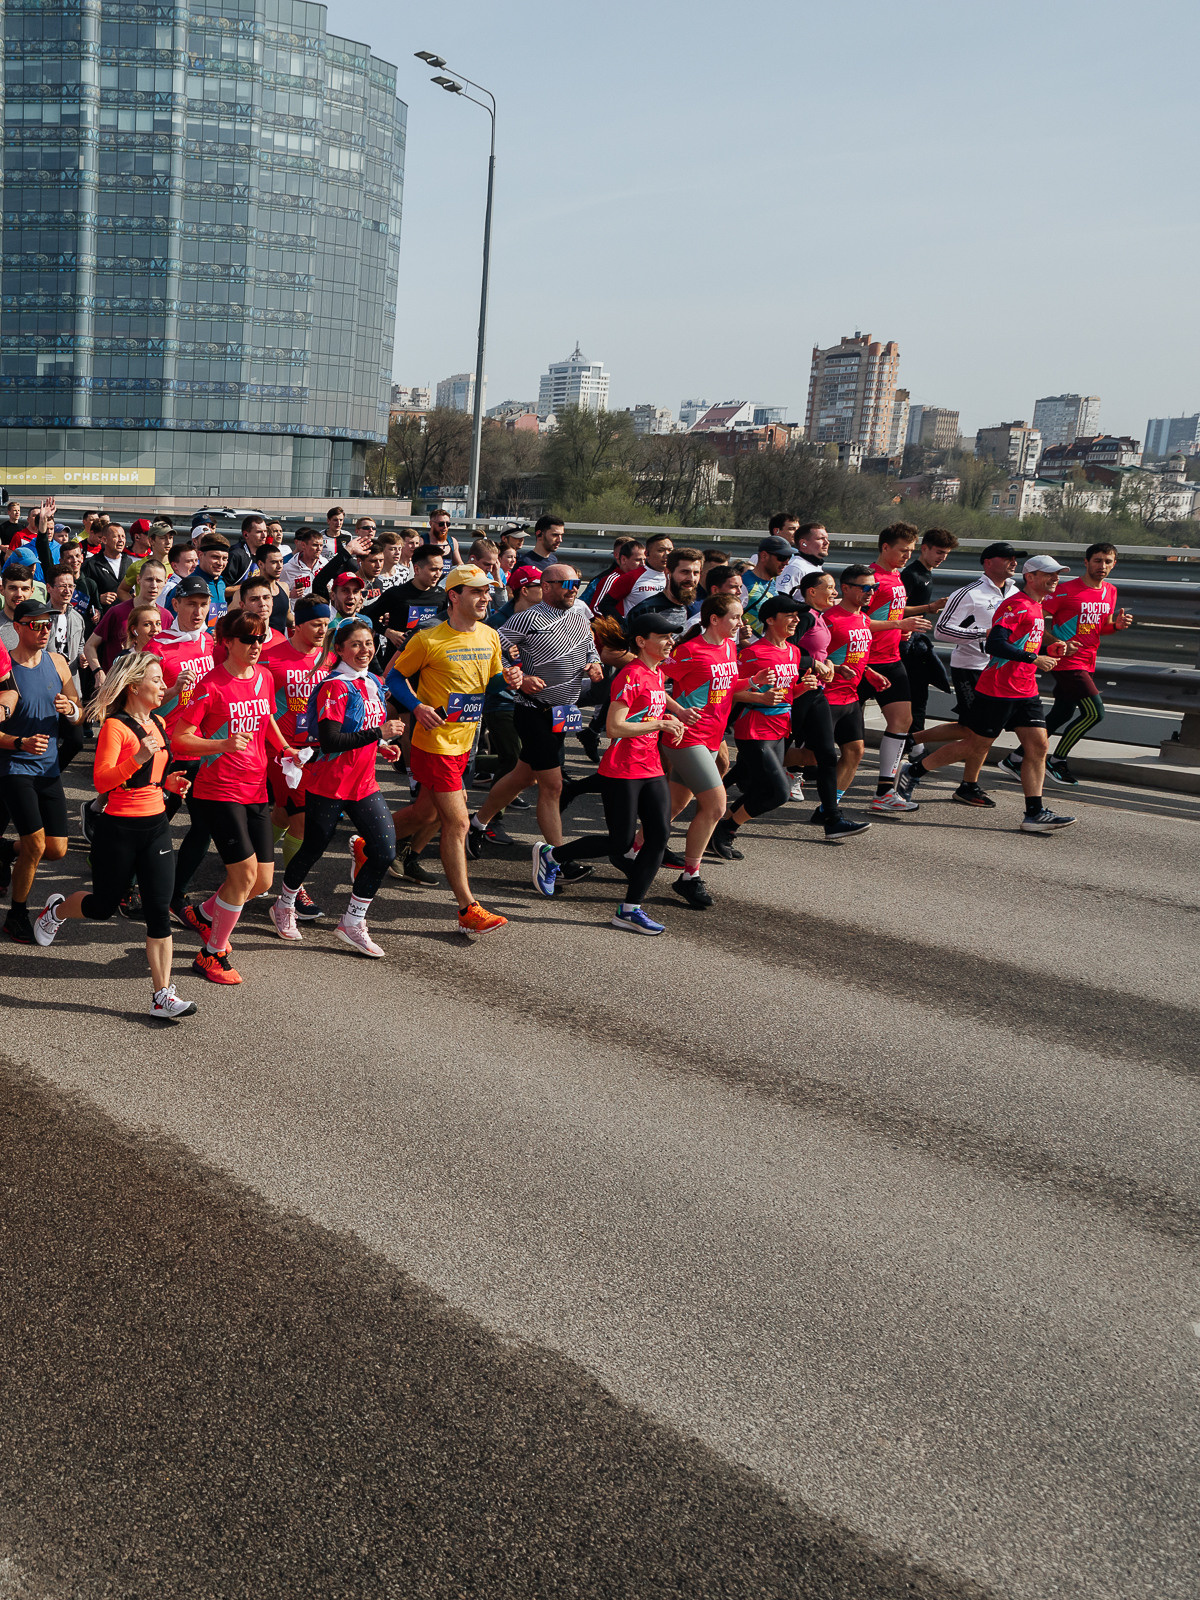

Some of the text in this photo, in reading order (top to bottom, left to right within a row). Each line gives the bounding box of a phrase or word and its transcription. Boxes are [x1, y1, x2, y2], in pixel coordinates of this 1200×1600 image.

[63, 471, 139, 481] ОГНЕННЫЙ
[1079, 613, 1102, 624] СКОЕ
[849, 640, 870, 652] СКОЕ
[711, 676, 734, 690] СКОЕ
[463, 703, 482, 713] 0061
[566, 713, 582, 722] 1677
[230, 715, 261, 733] СКОЕ
